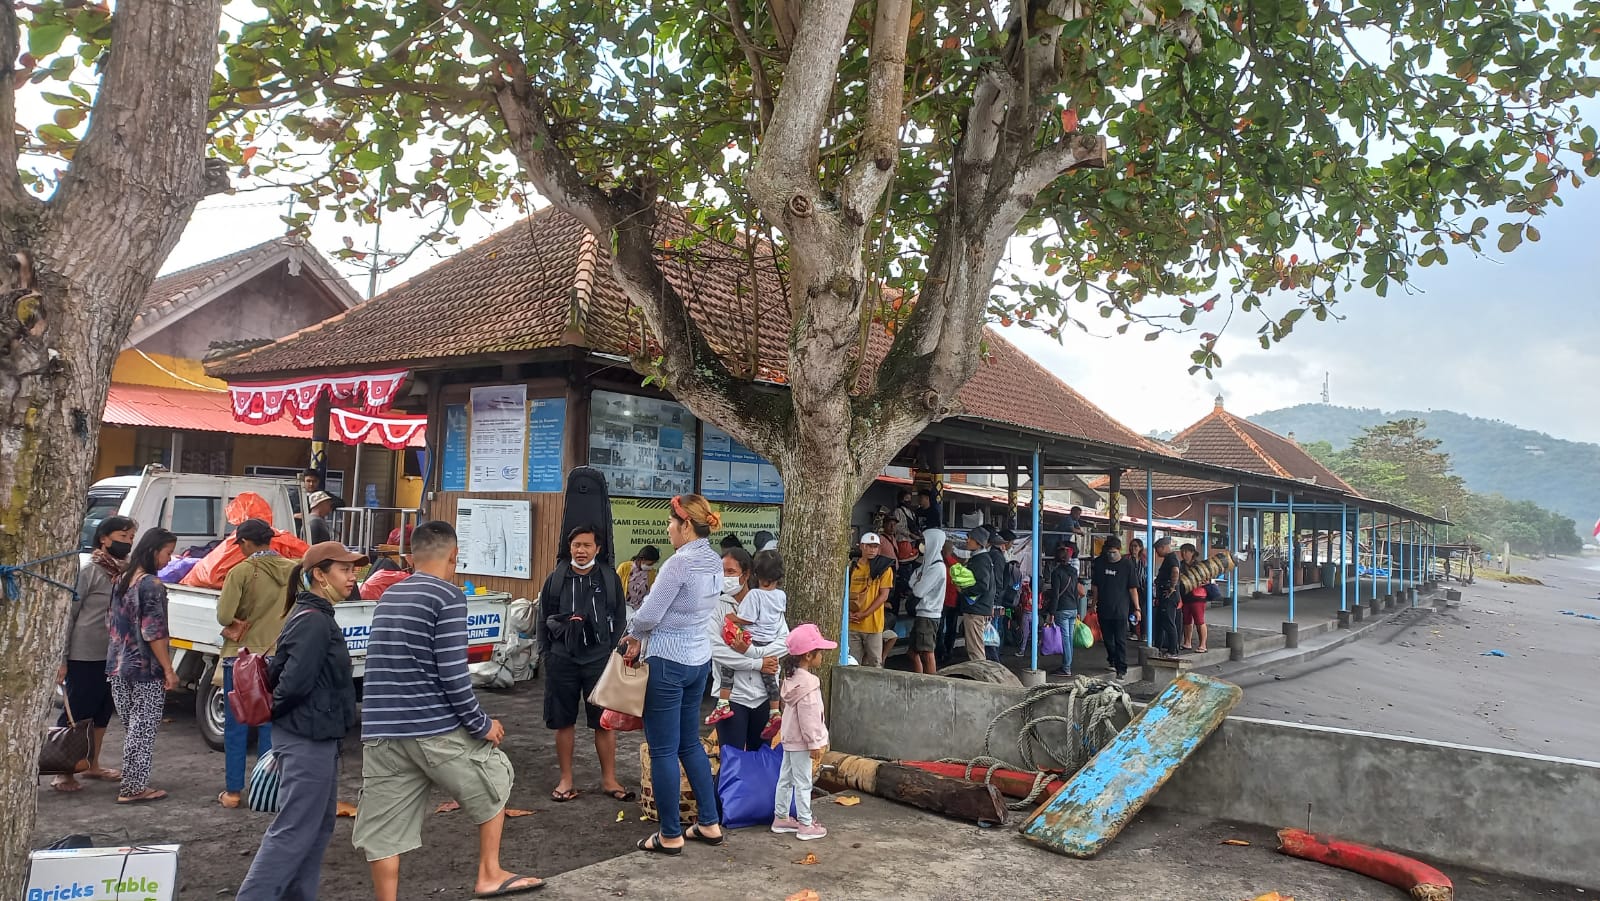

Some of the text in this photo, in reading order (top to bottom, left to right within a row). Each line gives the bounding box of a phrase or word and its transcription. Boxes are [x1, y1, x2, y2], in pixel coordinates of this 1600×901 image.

[631, 528, 666, 536] MENOLAK
[343, 625, 372, 638] UZU
[467, 628, 489, 639] ARINE
[346, 639, 368, 649] RIN
[28, 876, 159, 901] Bricks Table
